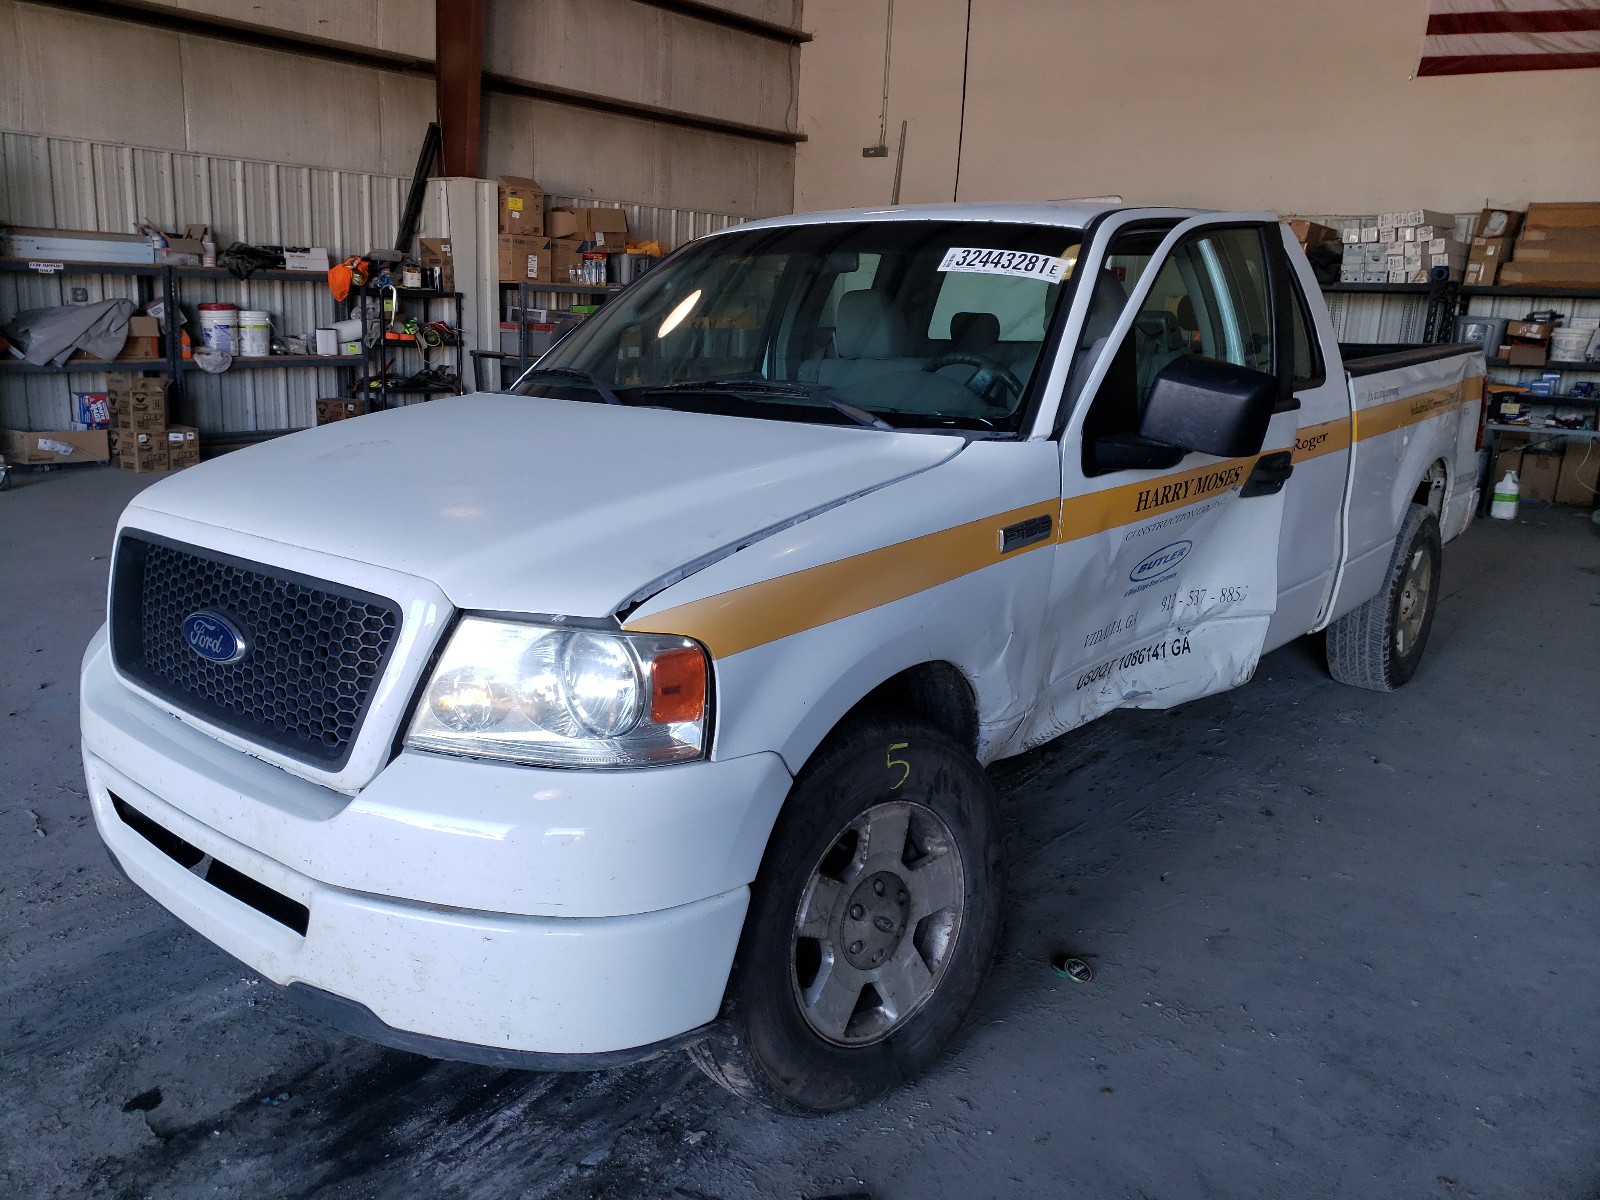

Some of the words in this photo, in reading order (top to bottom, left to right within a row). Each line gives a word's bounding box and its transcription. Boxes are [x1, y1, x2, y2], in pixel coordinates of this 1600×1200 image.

[955, 249, 1050, 275] 32443281
[1048, 264, 1059, 275] E
[1293, 431, 1329, 453] Roger
[1134, 478, 1197, 513] HARRY
[1192, 465, 1244, 496] MOSES
[1125, 507, 1195, 541] CONSTRUCTION
[1136, 546, 1187, 575] BUTLER
[1186, 589, 1207, 606] 537
[190, 620, 224, 654] Ford
[1117, 641, 1167, 671] 1086141
[1170, 636, 1192, 657] GA
[887, 742, 910, 790] 5
